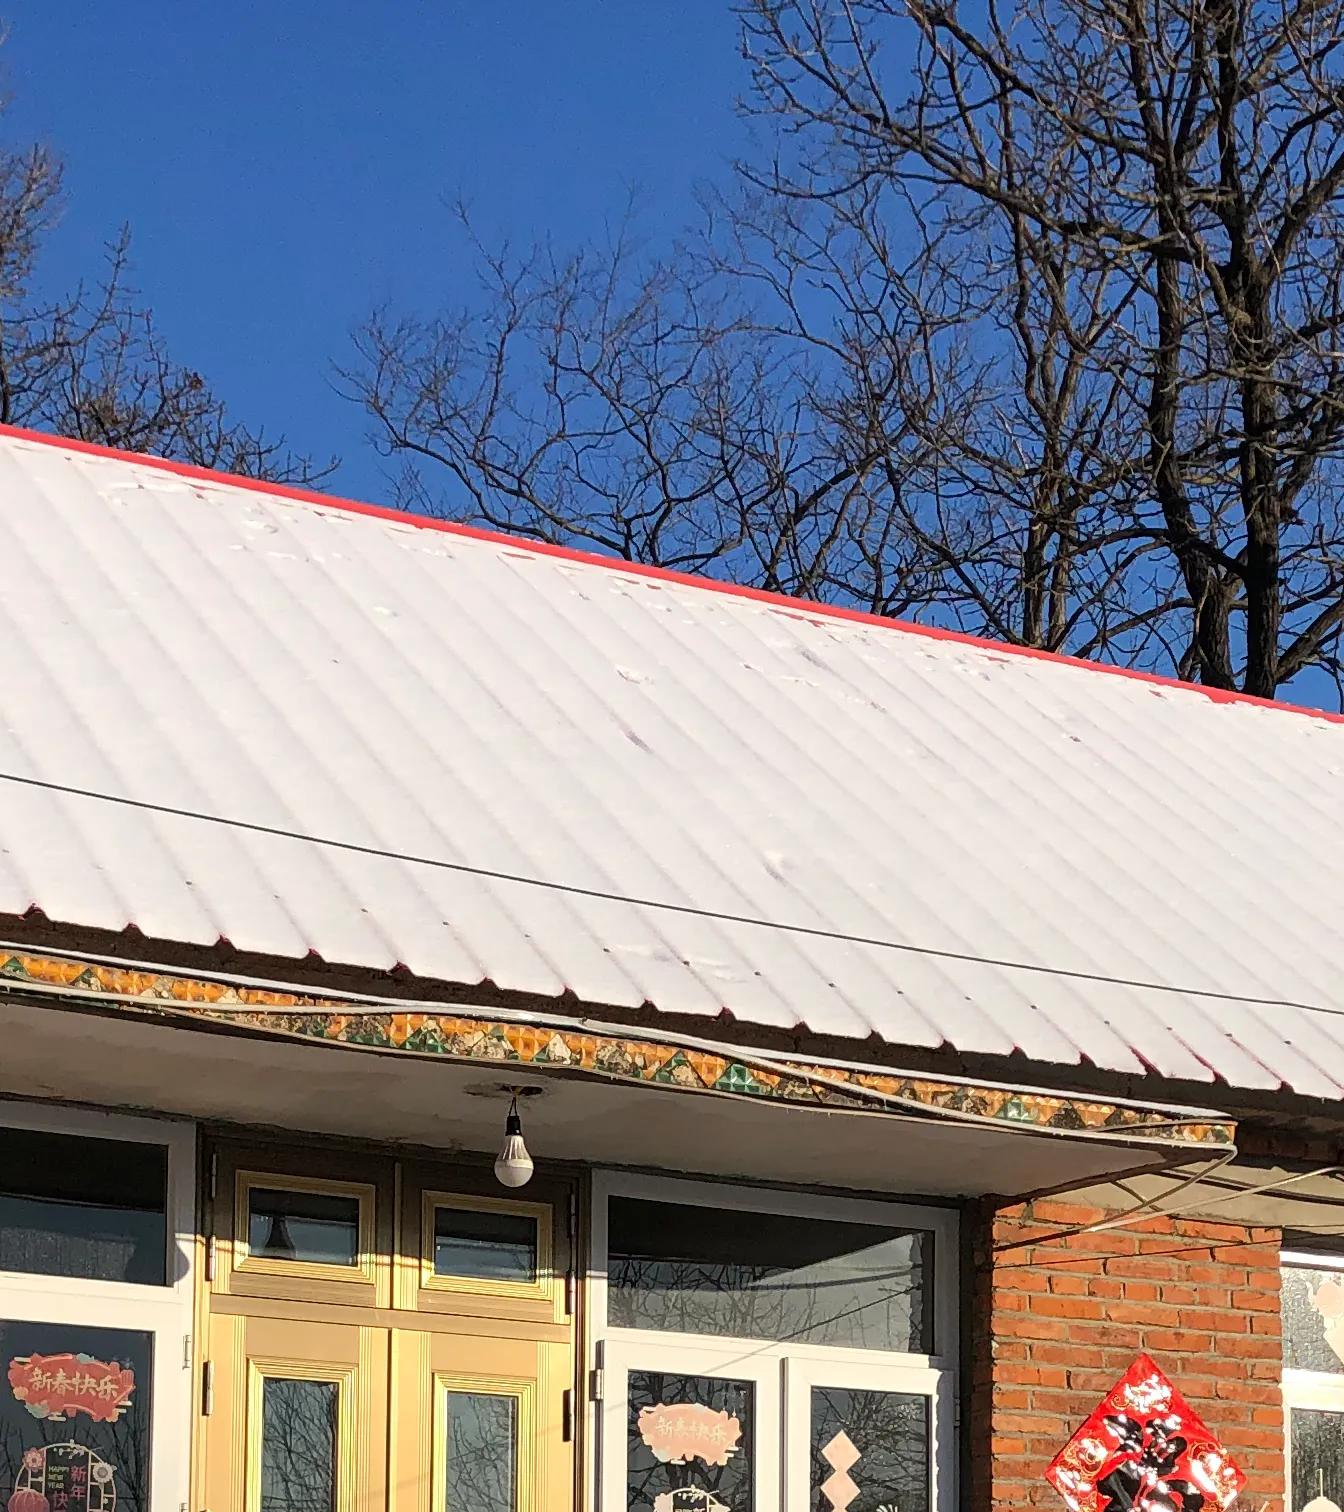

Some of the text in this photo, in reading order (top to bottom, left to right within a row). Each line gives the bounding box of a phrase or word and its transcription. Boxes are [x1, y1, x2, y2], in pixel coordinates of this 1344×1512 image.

[29, 1366, 119, 1400] 新春快乐
[70, 1465, 87, 1501] 新年
